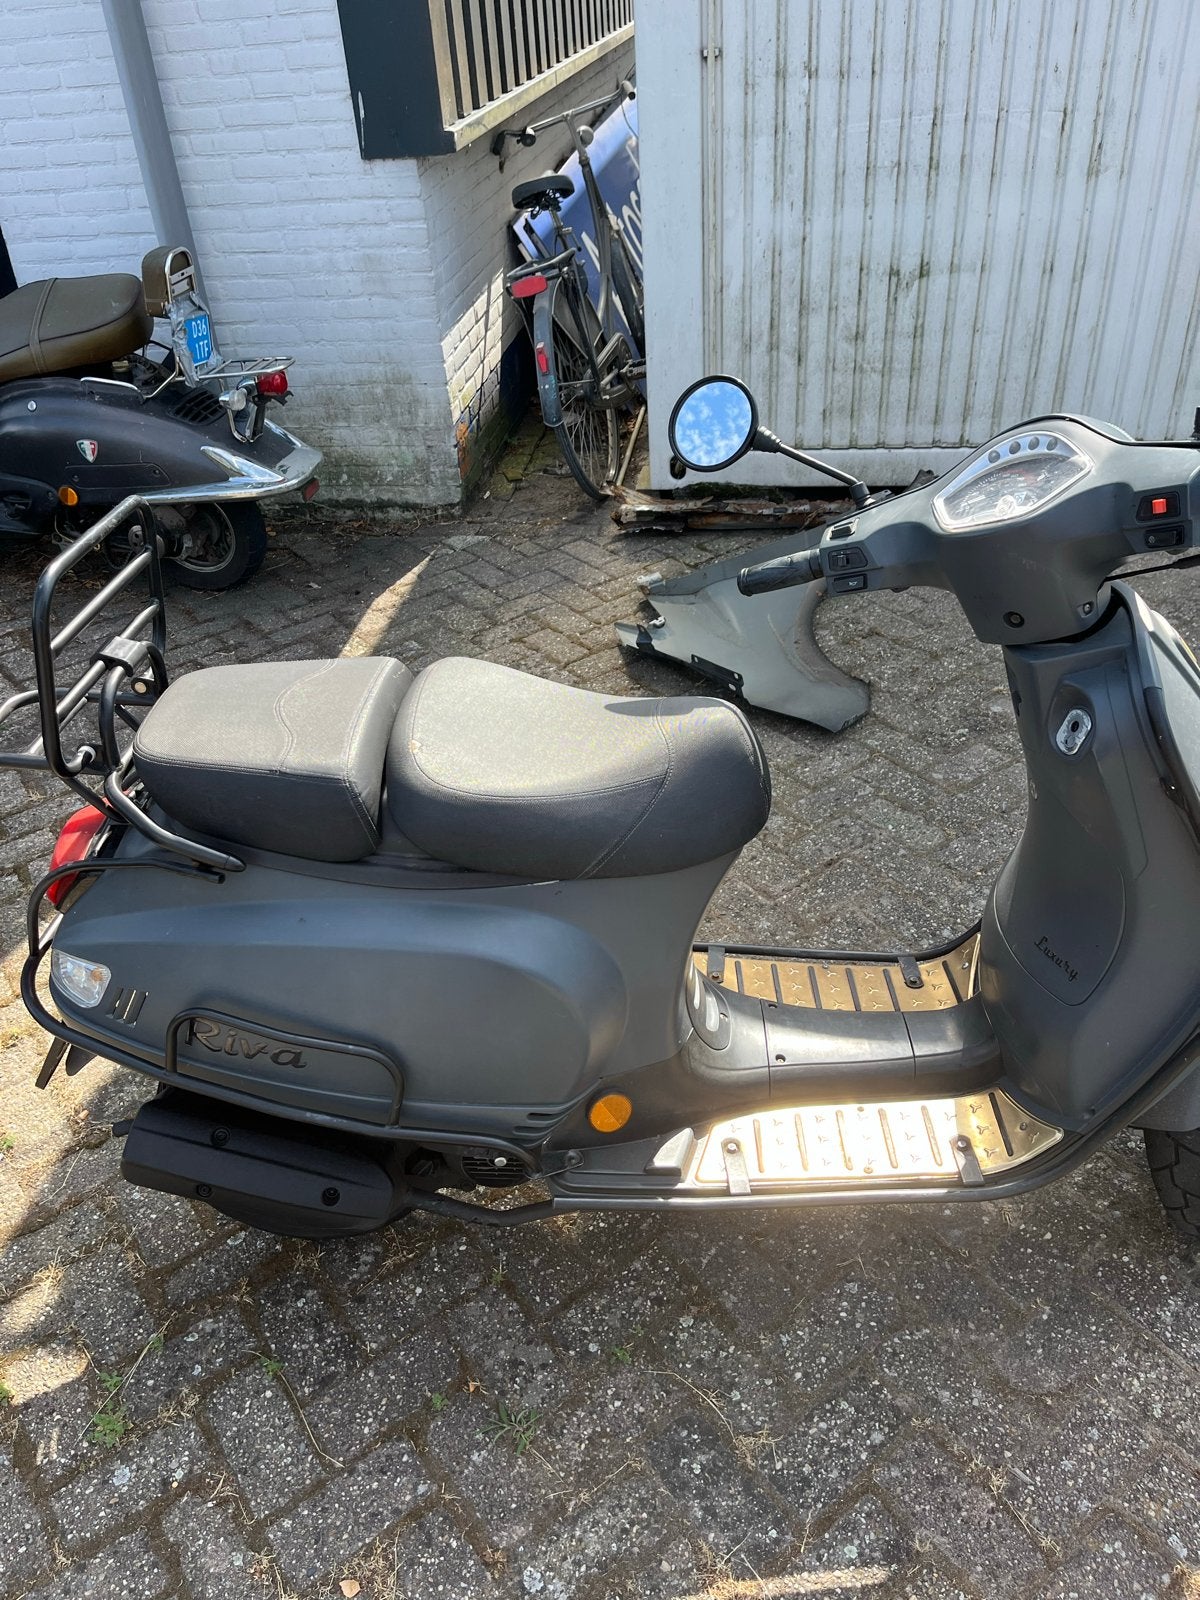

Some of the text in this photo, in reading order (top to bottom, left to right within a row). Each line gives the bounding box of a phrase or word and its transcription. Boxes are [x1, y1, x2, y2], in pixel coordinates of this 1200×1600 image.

[191, 319, 207, 338] D36
[1034, 936, 1079, 982] Luxury
[184, 1017, 308, 1069] Riva
